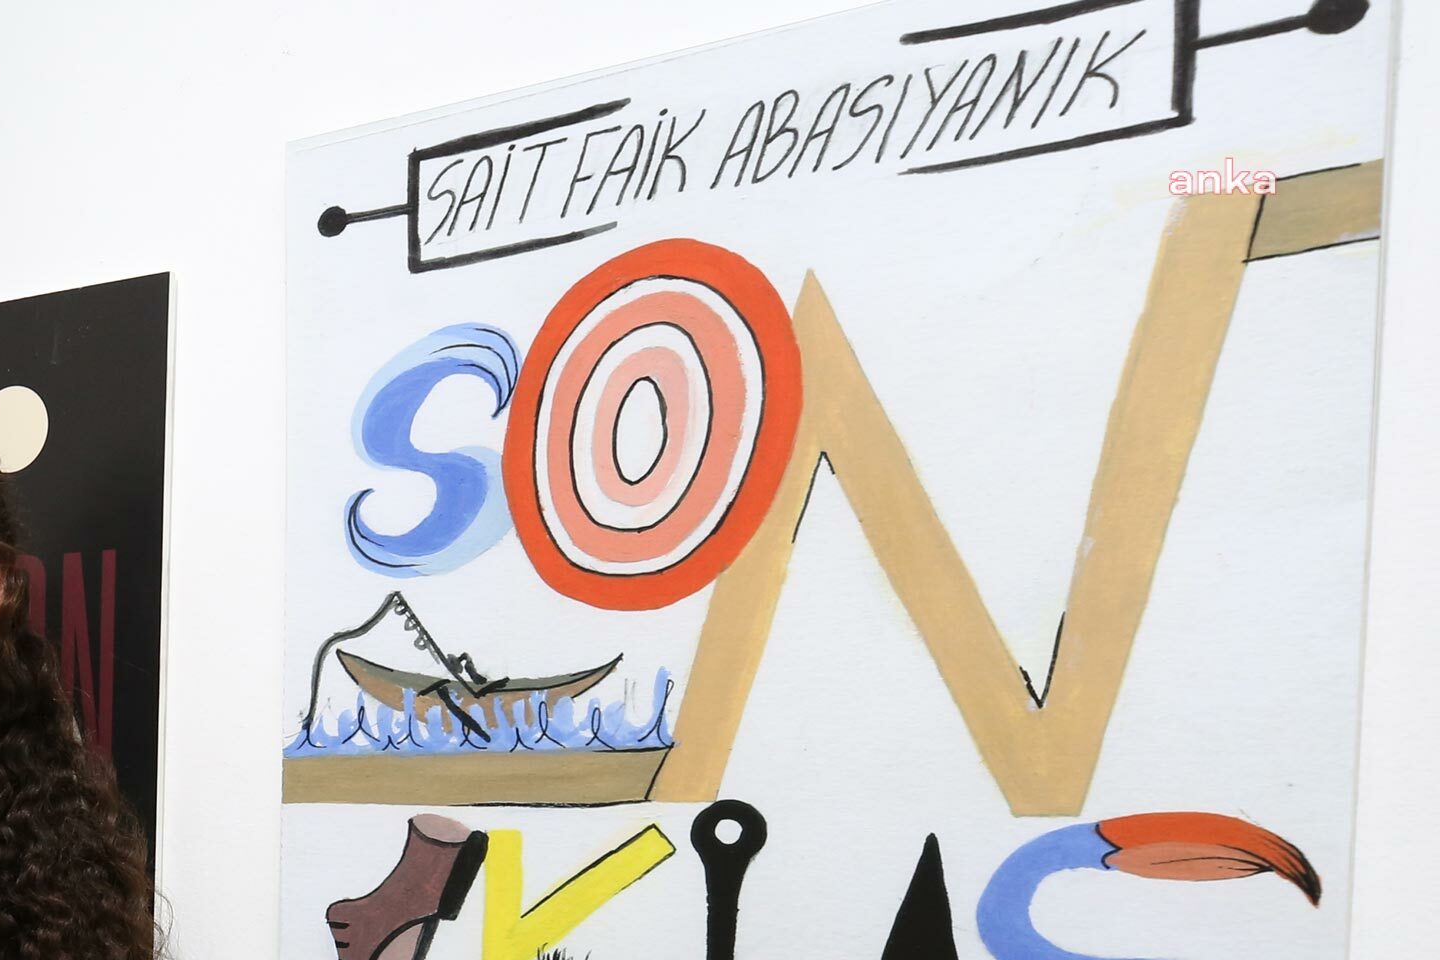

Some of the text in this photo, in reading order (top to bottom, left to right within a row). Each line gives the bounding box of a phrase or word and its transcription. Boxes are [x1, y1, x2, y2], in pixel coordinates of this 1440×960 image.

[424, 29, 1147, 244] SAİT FAİK ABASIYANIK
